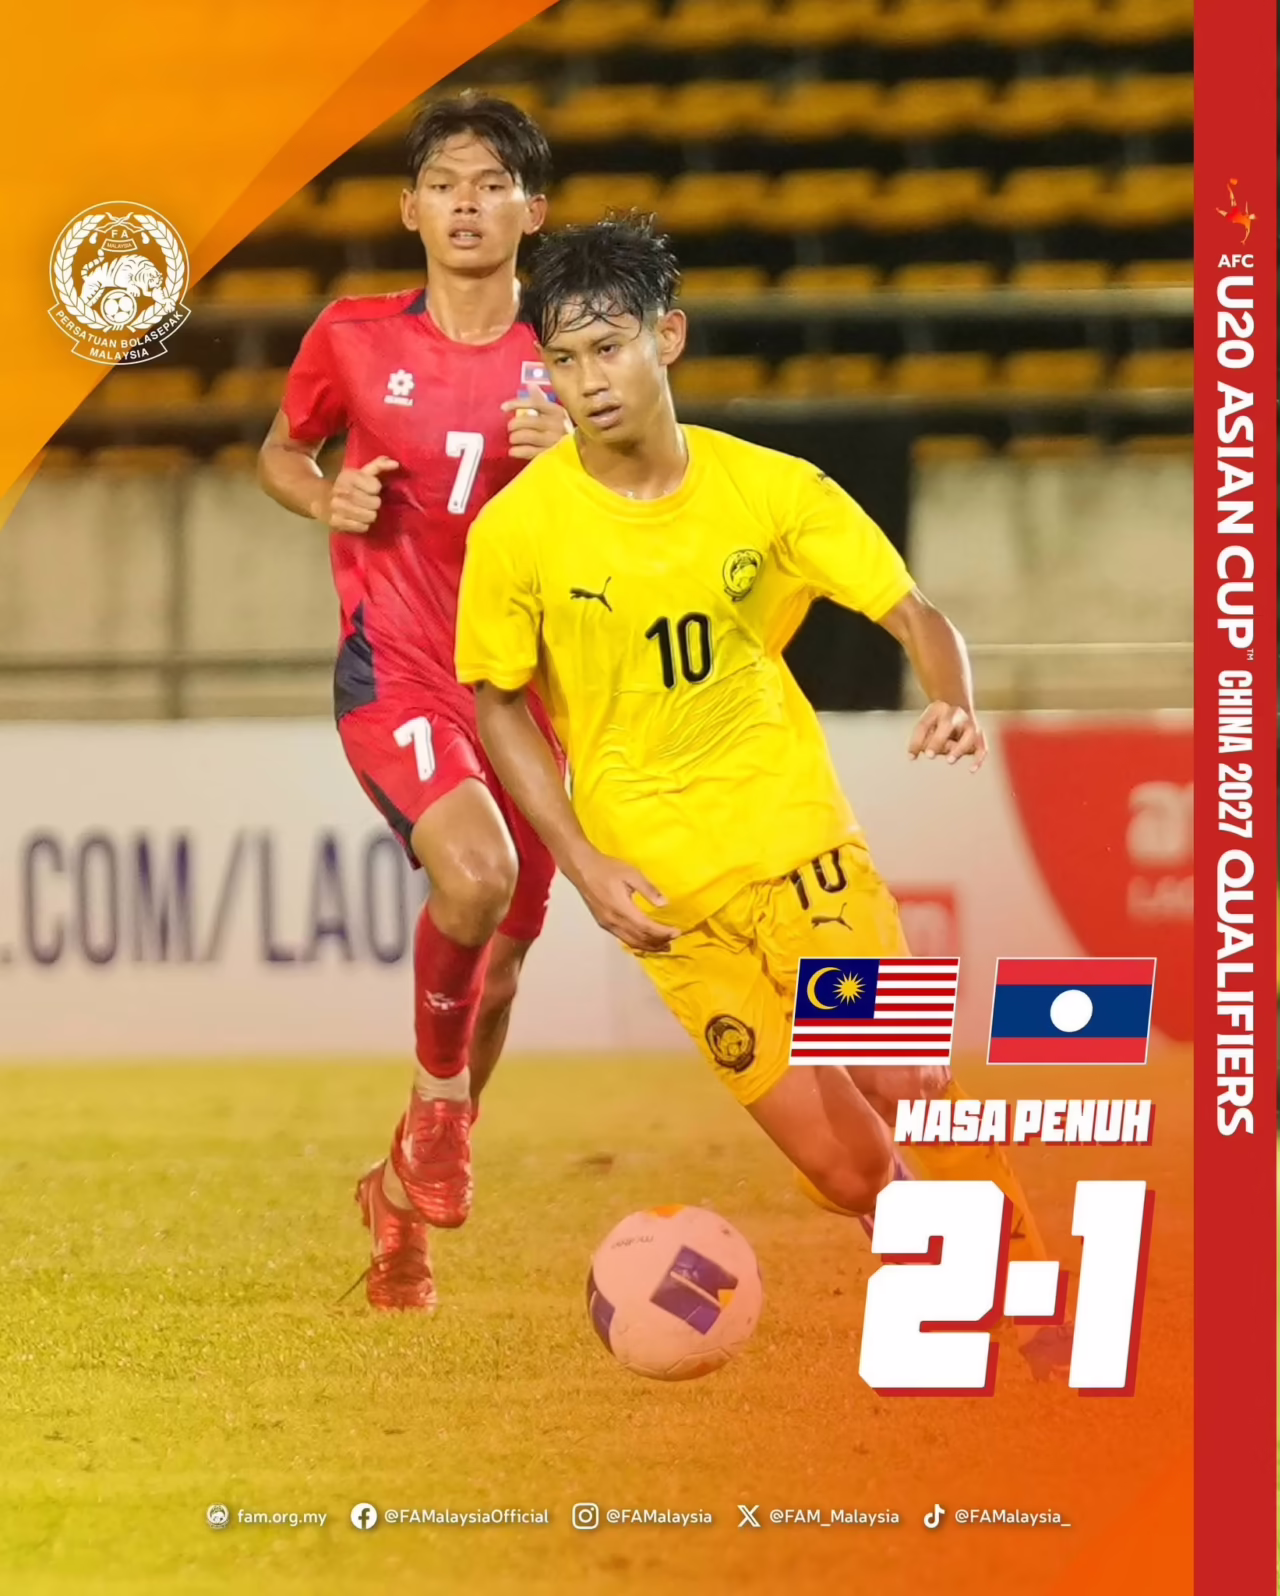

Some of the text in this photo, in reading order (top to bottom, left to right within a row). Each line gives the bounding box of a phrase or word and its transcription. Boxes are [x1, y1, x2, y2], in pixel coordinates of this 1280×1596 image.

[446, 430, 484, 514] 7
[645, 611, 714, 689] 10
[394, 716, 436, 781] 7
[0, 834, 426, 965] .COM/LAO
